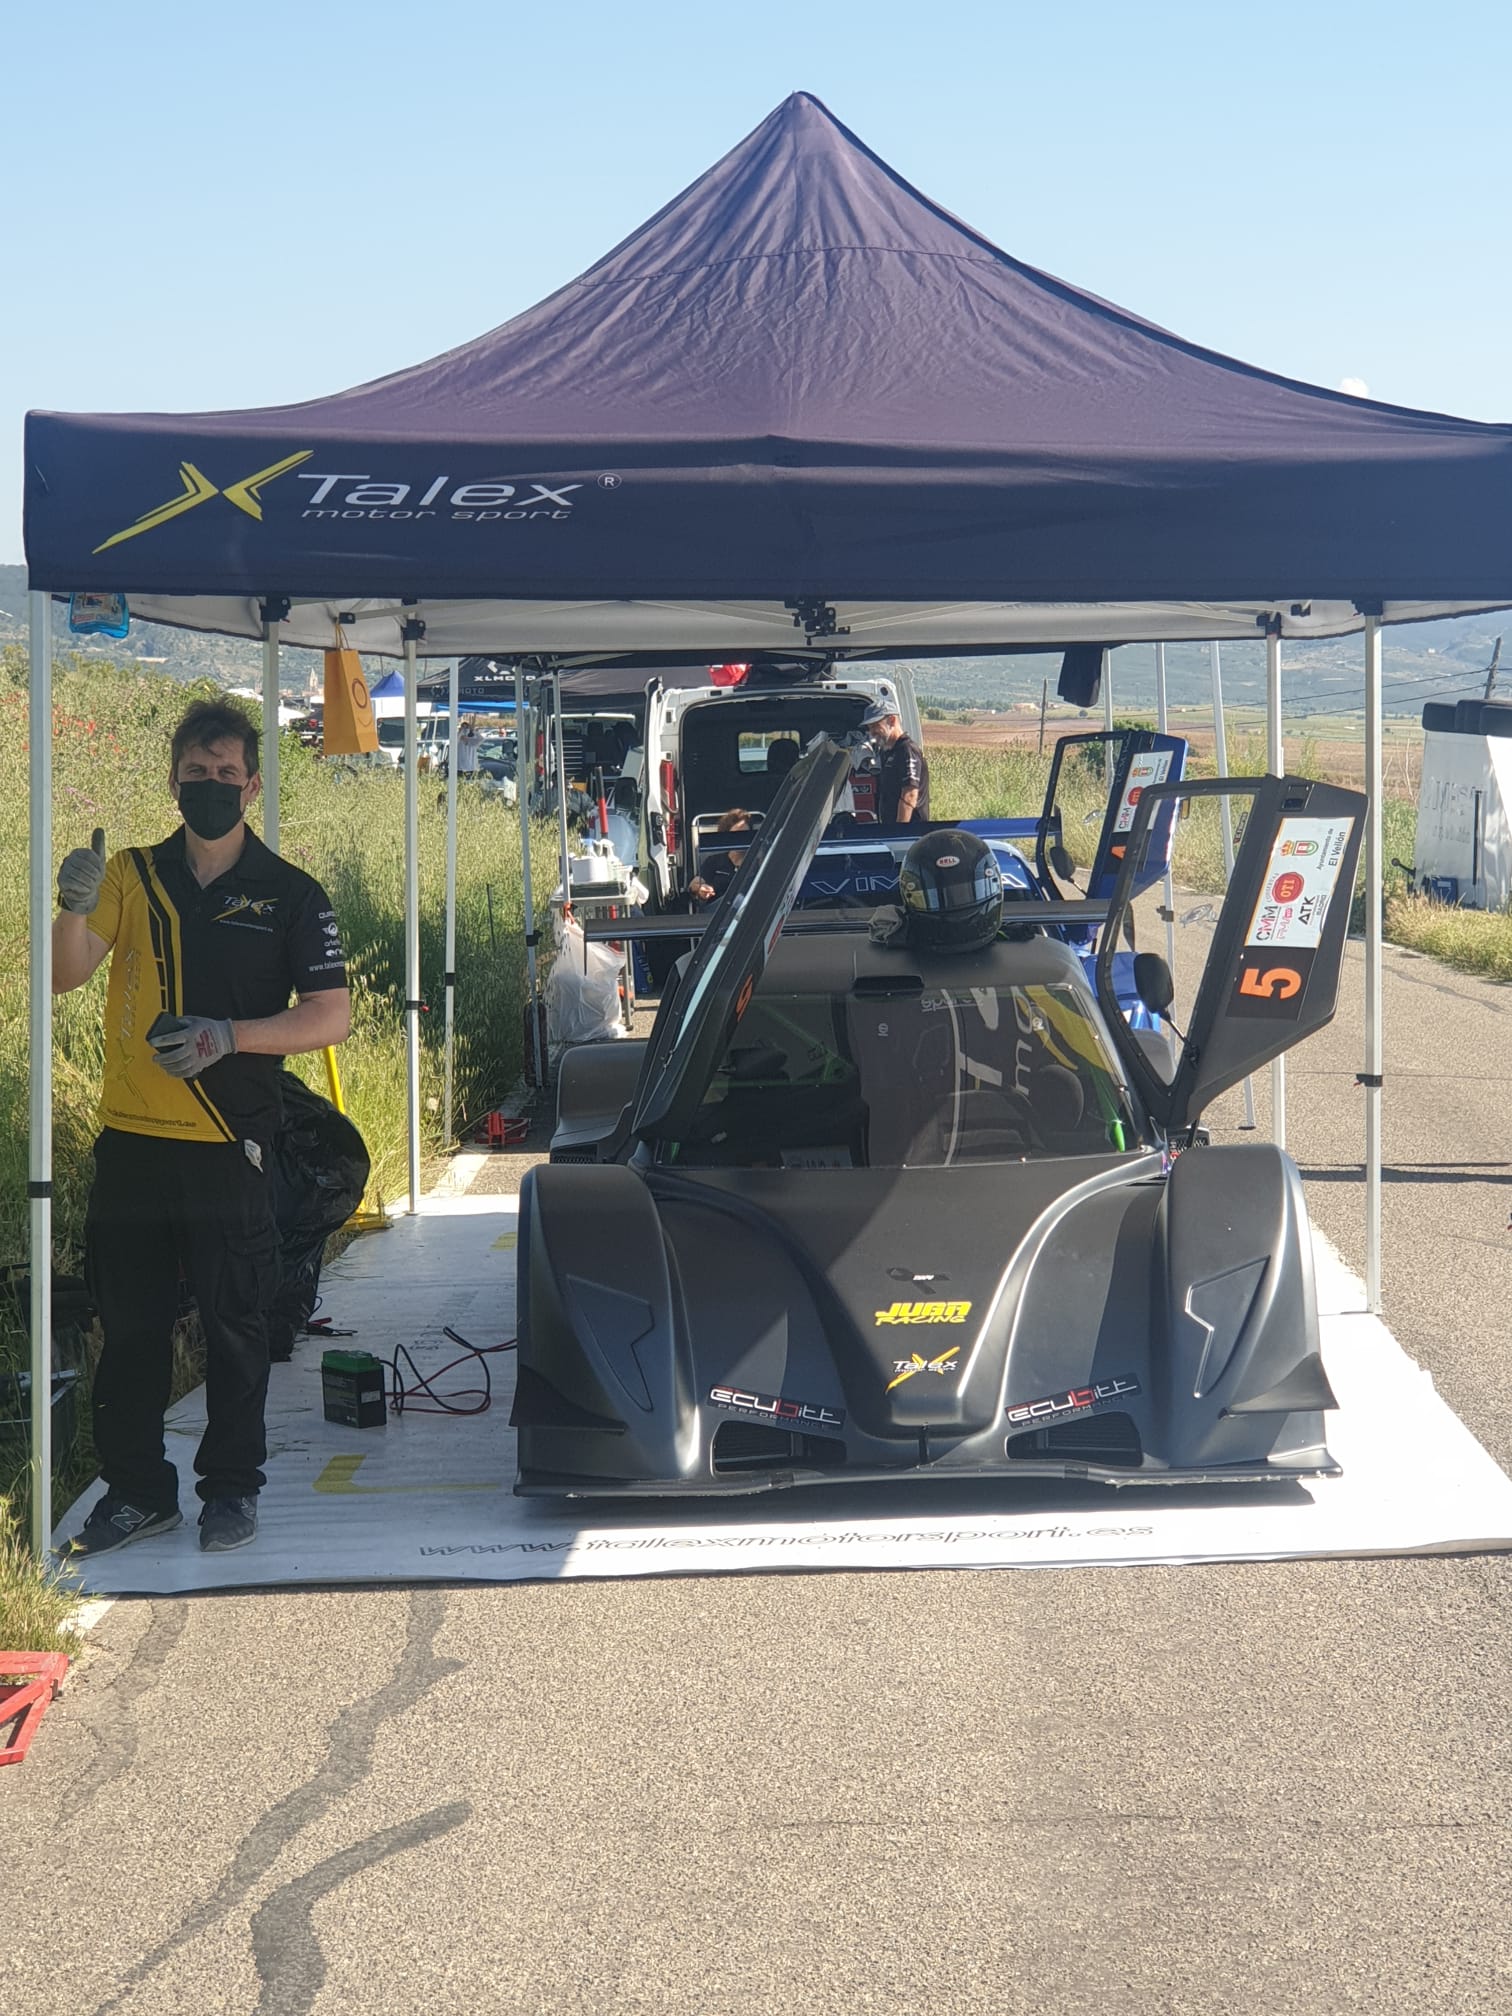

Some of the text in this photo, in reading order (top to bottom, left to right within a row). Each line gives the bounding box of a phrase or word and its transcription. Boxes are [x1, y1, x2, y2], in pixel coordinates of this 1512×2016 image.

[298, 473, 584, 506] Talex
[302, 509, 571, 522] motor sport
[1328, 831, 1346, 867] El Vellón
[810, 874, 1030, 895] VIMA
[1256, 905, 1279, 941] CMM
[1298, 895, 1316, 926] ATK
[1240, 967, 1302, 1000] 5
[875, 1315, 967, 1326] RACING
[893, 1359, 958, 1370] Talex
[419, 1526, 1154, 1556] www.talexmotorsport.es
